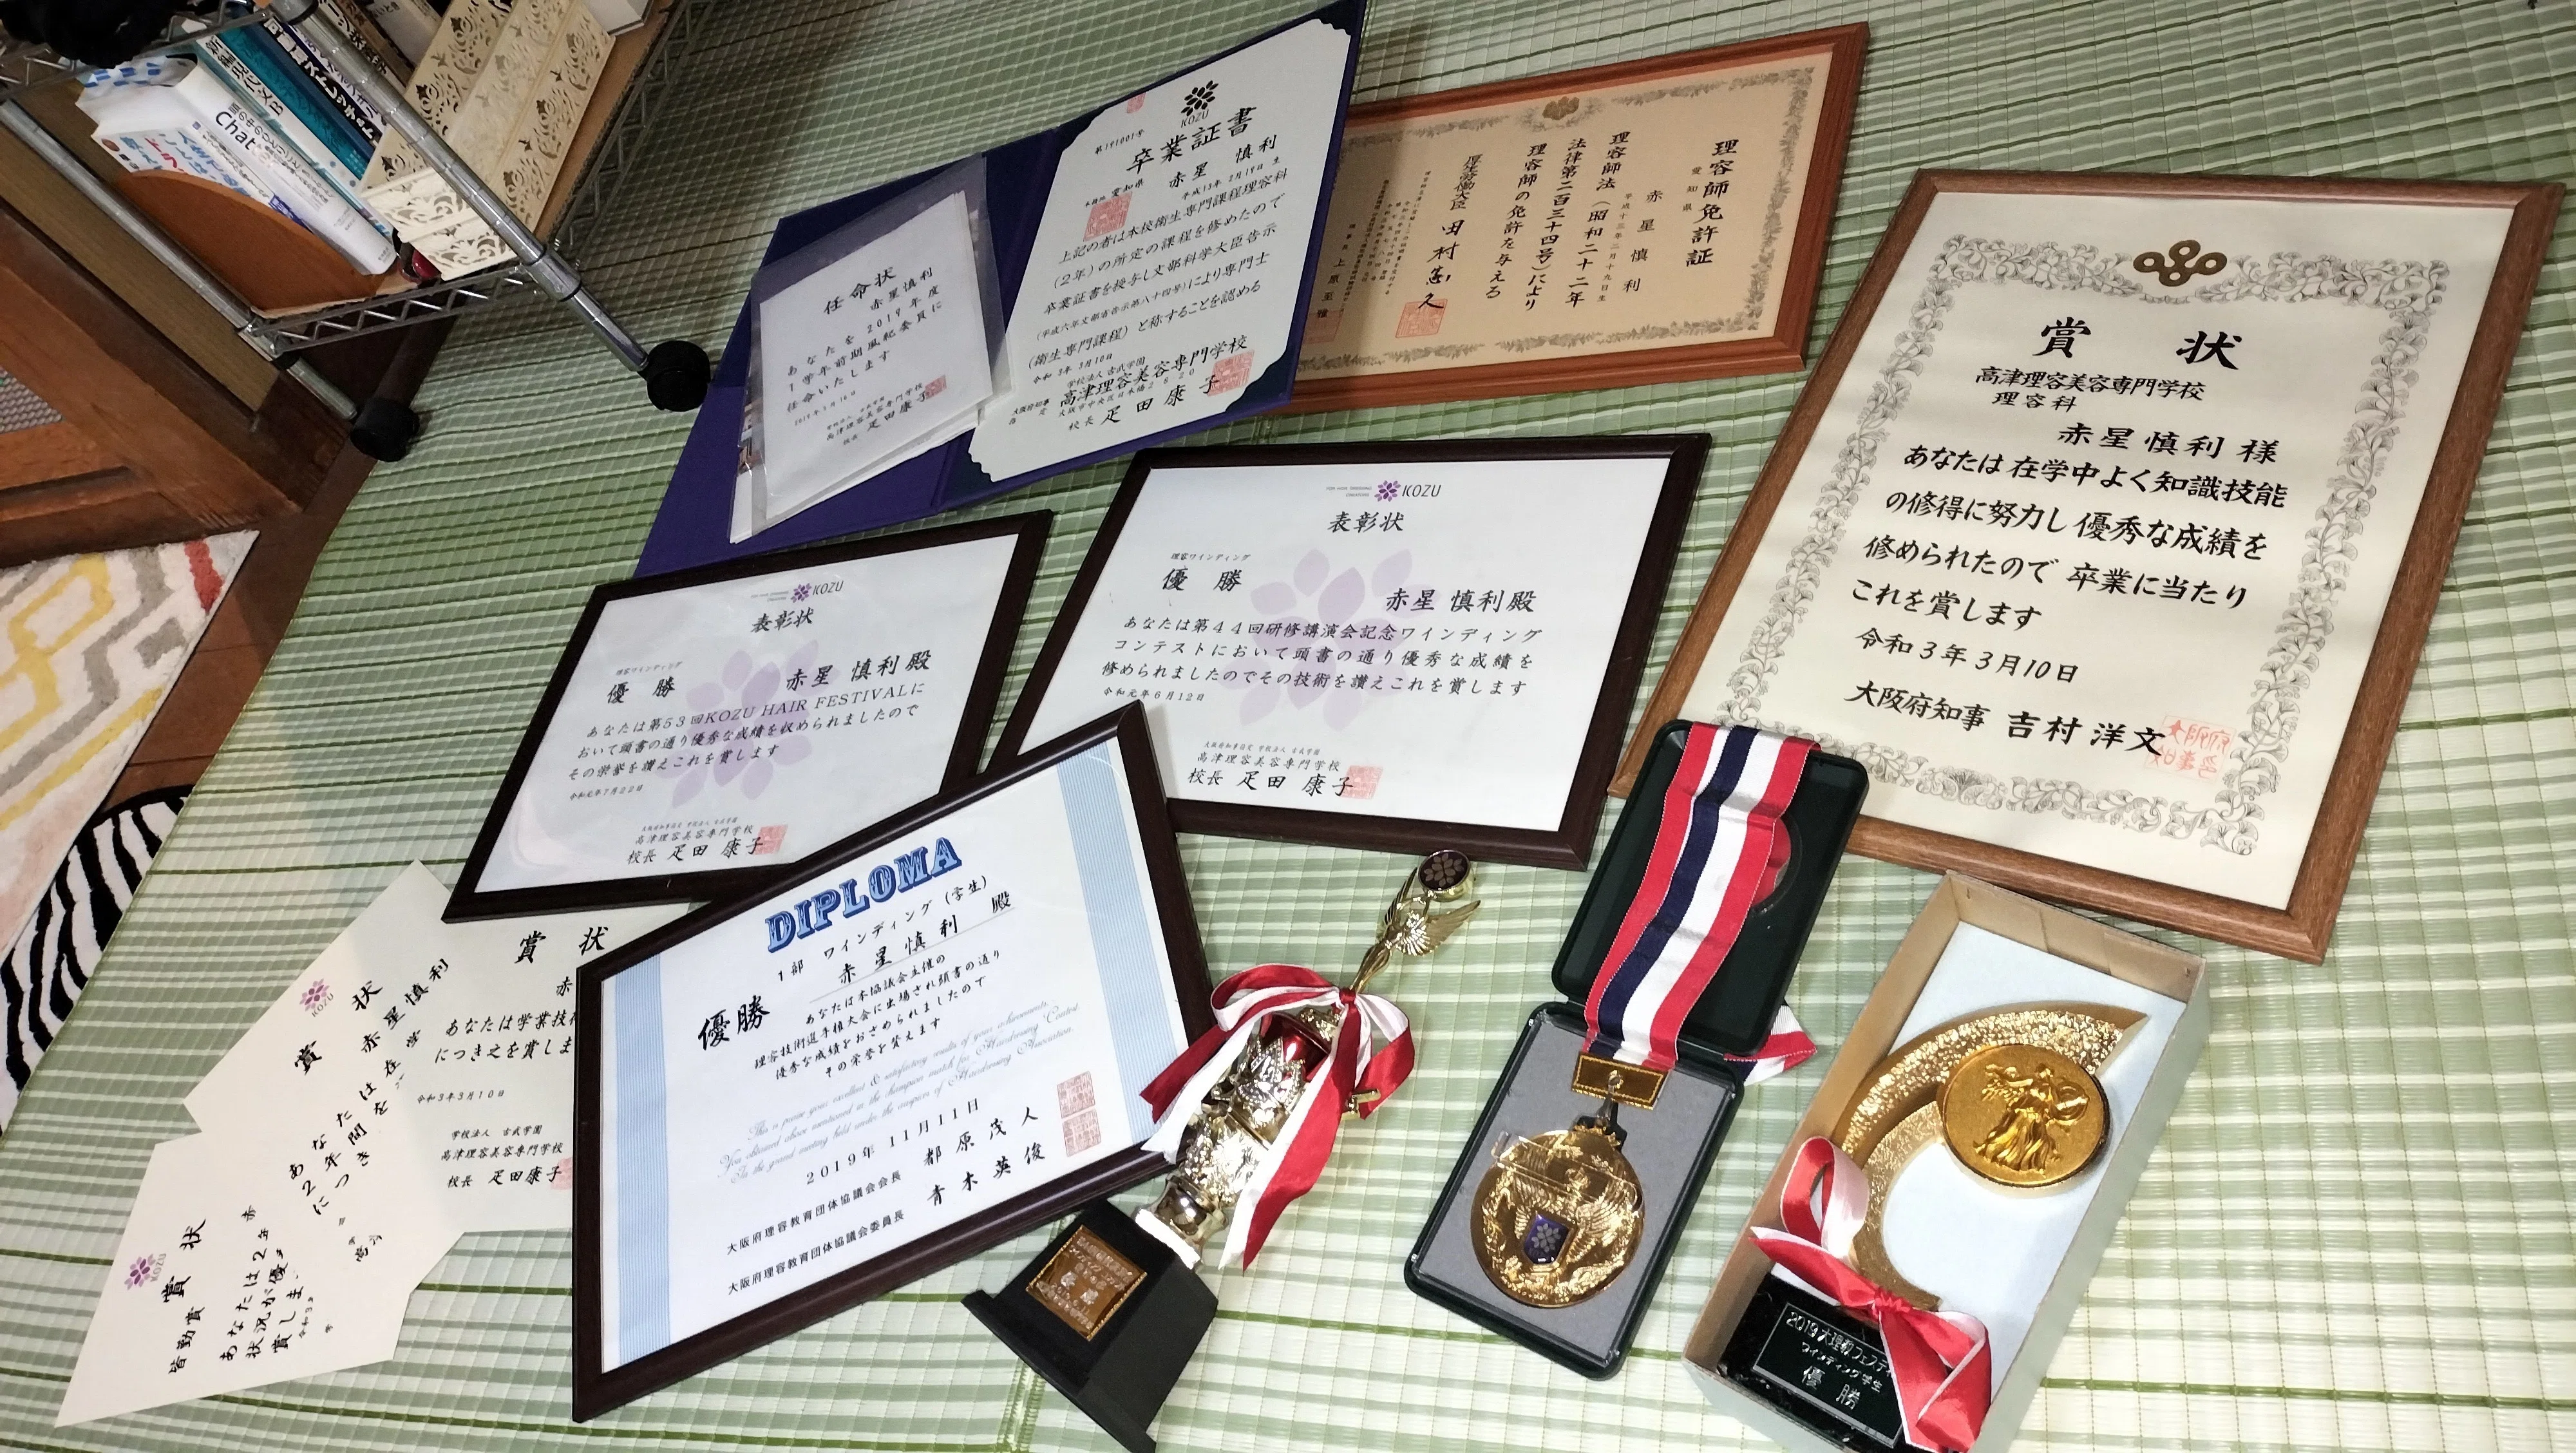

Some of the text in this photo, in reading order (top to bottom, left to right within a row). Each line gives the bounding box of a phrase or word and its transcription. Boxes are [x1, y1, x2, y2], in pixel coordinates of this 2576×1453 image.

[205, 37, 285, 117] 新編現代文B
[1126, 106, 1257, 175] 卒業証書
[1180, 109, 1209, 128] KOZU
[1485, 142, 1548, 299] 理容師の免許を与える
[1685, 138, 1739, 267] 理容師免許証
[1622, 189, 1664, 294] 赤星慎利
[822, 266, 897, 316] 任命状
[1059, 334, 1248, 408] 高津理容美容専門学校
[1974, 365, 2207, 403] 高津理容美容専門学校
[1991, 390, 2078, 413] 理容科
[2056, 422, 2282, 466] 赤星慎利様
[1401, 484, 1442, 498] KOZU
[1903, 444, 2290, 509] あなたは在学中よく知識技能
[1327, 511, 1405, 533] 表彰状
[1885, 491, 2269, 562] の修得に努力し優秀な成績を
[812, 580, 844, 596] KOZU
[1862, 535, 2250, 609] 修められたので卒業に当たり
[750, 607, 815, 633] 表彰状
[1385, 587, 1537, 613] 赤星 慎利殿
[1851, 580, 2043, 631] これを賞します
[1114, 640, 1533, 671] コンテストにおいて頭書の通り優秀な成績を
[1123, 615, 1543, 645] あなたは第44回研修講演会記念ワインディング
[1854, 627, 2079, 685] 令和3年3月10日
[606, 675, 676, 704] 優勝
[786, 649, 932, 692] 赤星 慎利殿
[760, 699, 808, 717] HAIR
[1843, 680, 2168, 757] 大阪府知事 吉村洋文
[1187, 766, 1224, 786] 校長
[1197, 751, 1342, 772] 高津理容美容専門学校
[764, 837, 962, 953] DIPLOMA
[823, 898, 933, 960] ワインディング
[837, 890, 1012, 985] 赤星慎利 殿
[294, 980, 384, 1076] 賞状
[311, 993, 335, 1018] KOZU
[361, 958, 449, 1054] 赤星慎利
[697, 994, 771, 1051] 優勝
[806, 1097, 978, 1185] 2019年11月11日
[726, 1170, 902, 1255] 大阪府理容教育団体協議会会長
[728, 1141, 1046, 1296] 大阪府理容教育団体協議会委員長 青木英俊
[149, 1252, 167, 1283] KOZU
[160, 1219, 207, 1303] 賞状
[1801, 1365, 1862, 1411] 優勝
